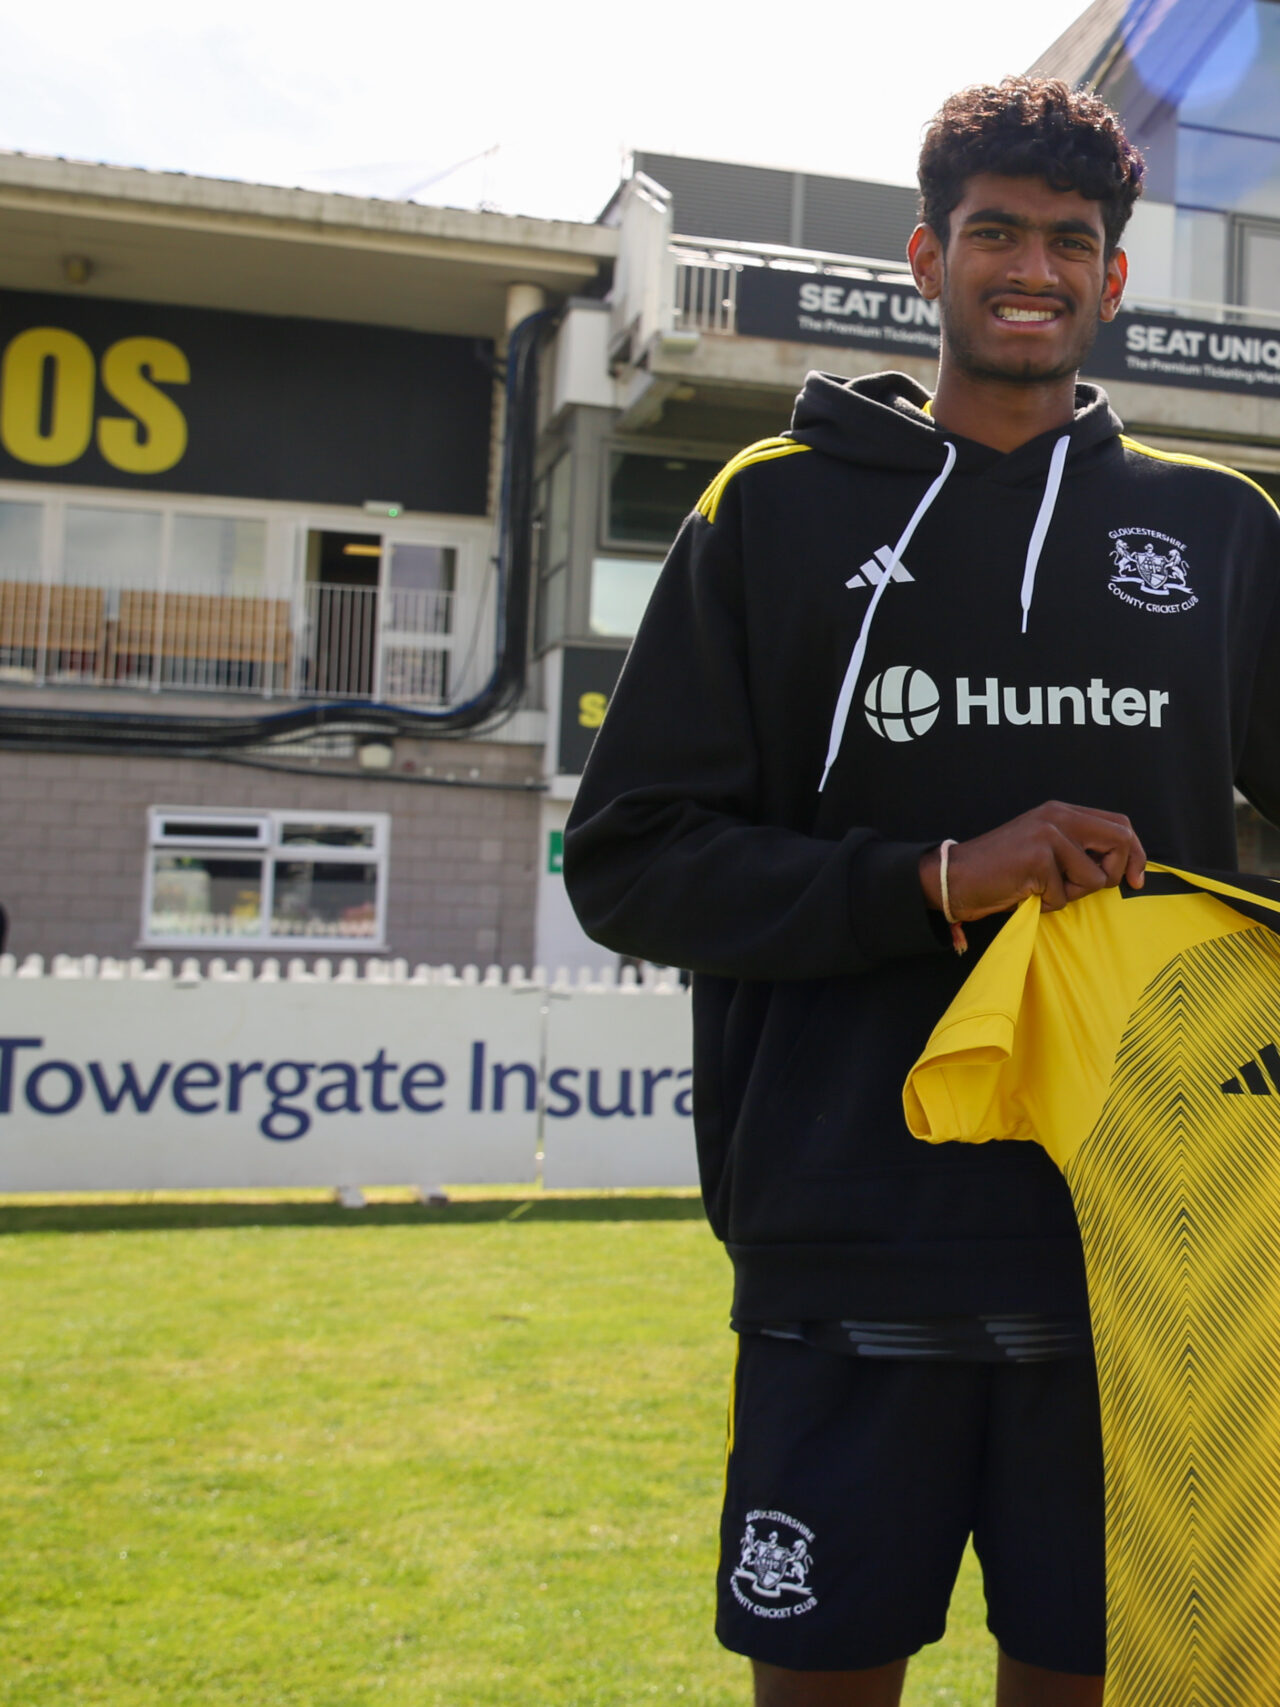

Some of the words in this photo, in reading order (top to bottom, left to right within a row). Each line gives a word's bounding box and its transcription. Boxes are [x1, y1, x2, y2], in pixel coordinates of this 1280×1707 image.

[798, 282, 887, 319] SEAT
[798, 315, 822, 331] The
[824, 318, 881, 338] Premium
[1126, 324, 1205, 358] SEAT
[1126, 355, 1148, 370] The
[1149, 359, 1202, 376] Premium
[1108, 527, 1187, 551] GLOUCESTERSHIRE
[1107, 582, 1145, 609] COUNTY
[1146, 602, 1180, 613] CRICKET
[1181, 595, 1199, 611] CLUB
[956, 677, 1169, 728] Hunter
[794, 1596, 818, 1615] CLUB
